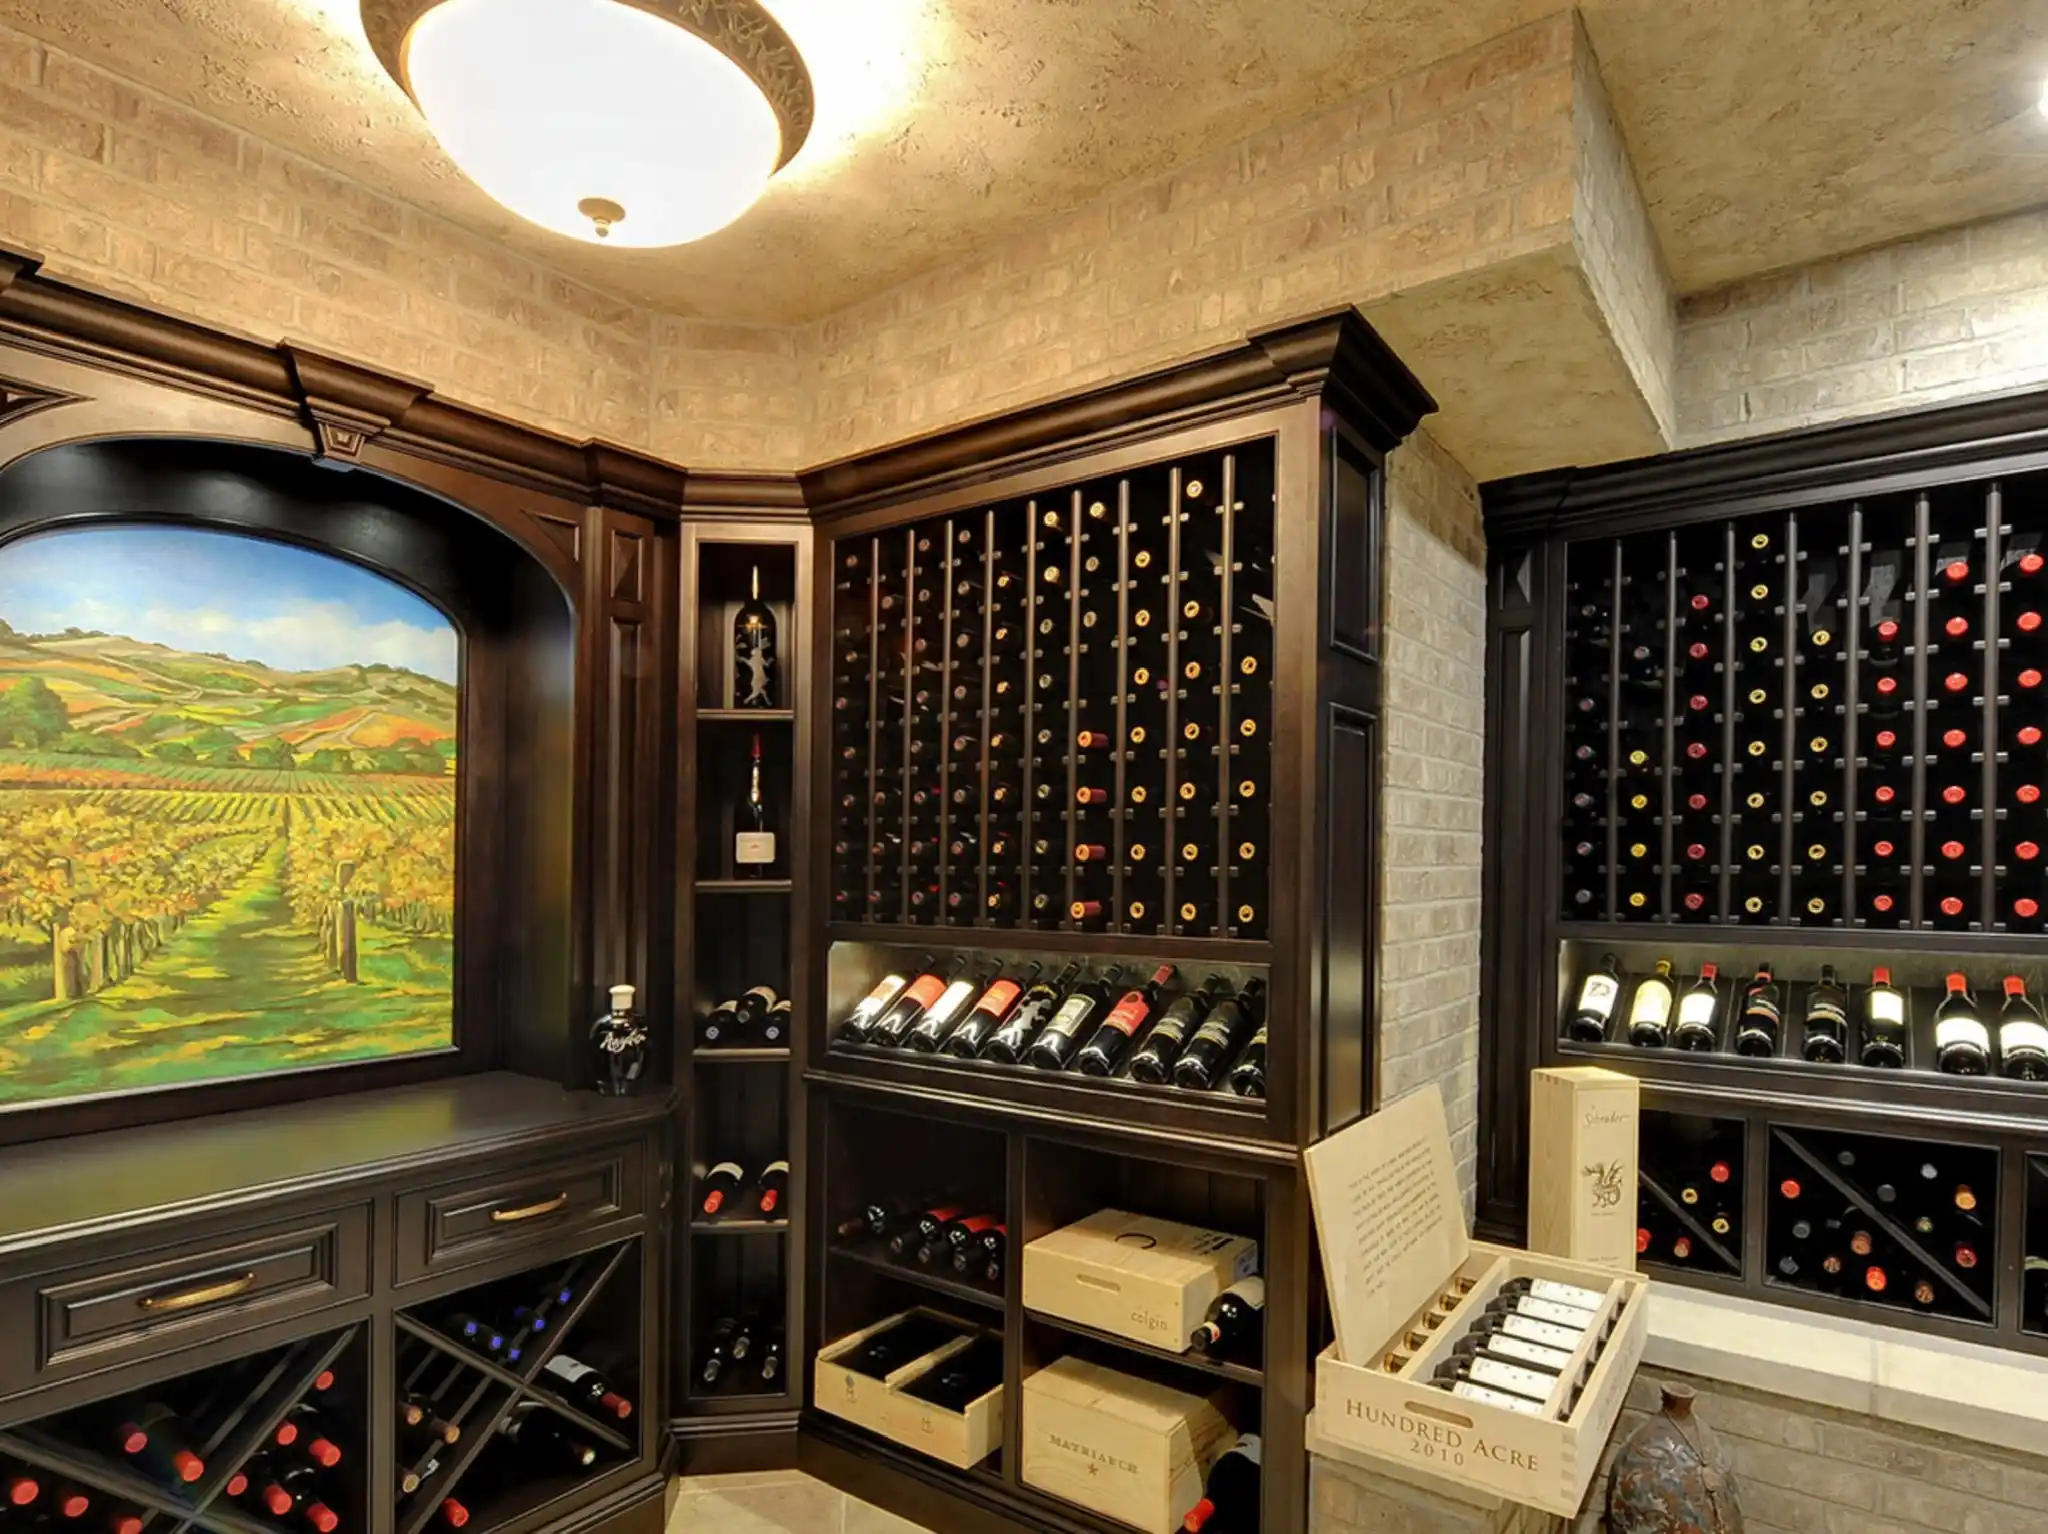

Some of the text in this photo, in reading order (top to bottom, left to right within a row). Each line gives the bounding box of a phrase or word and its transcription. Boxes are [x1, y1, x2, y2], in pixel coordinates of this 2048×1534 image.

[1048, 1434, 1138, 1474] MATRIARCH
[1346, 1399, 1539, 1472] HUNDRED ACRE
[1410, 1440, 1465, 1467] 2010
